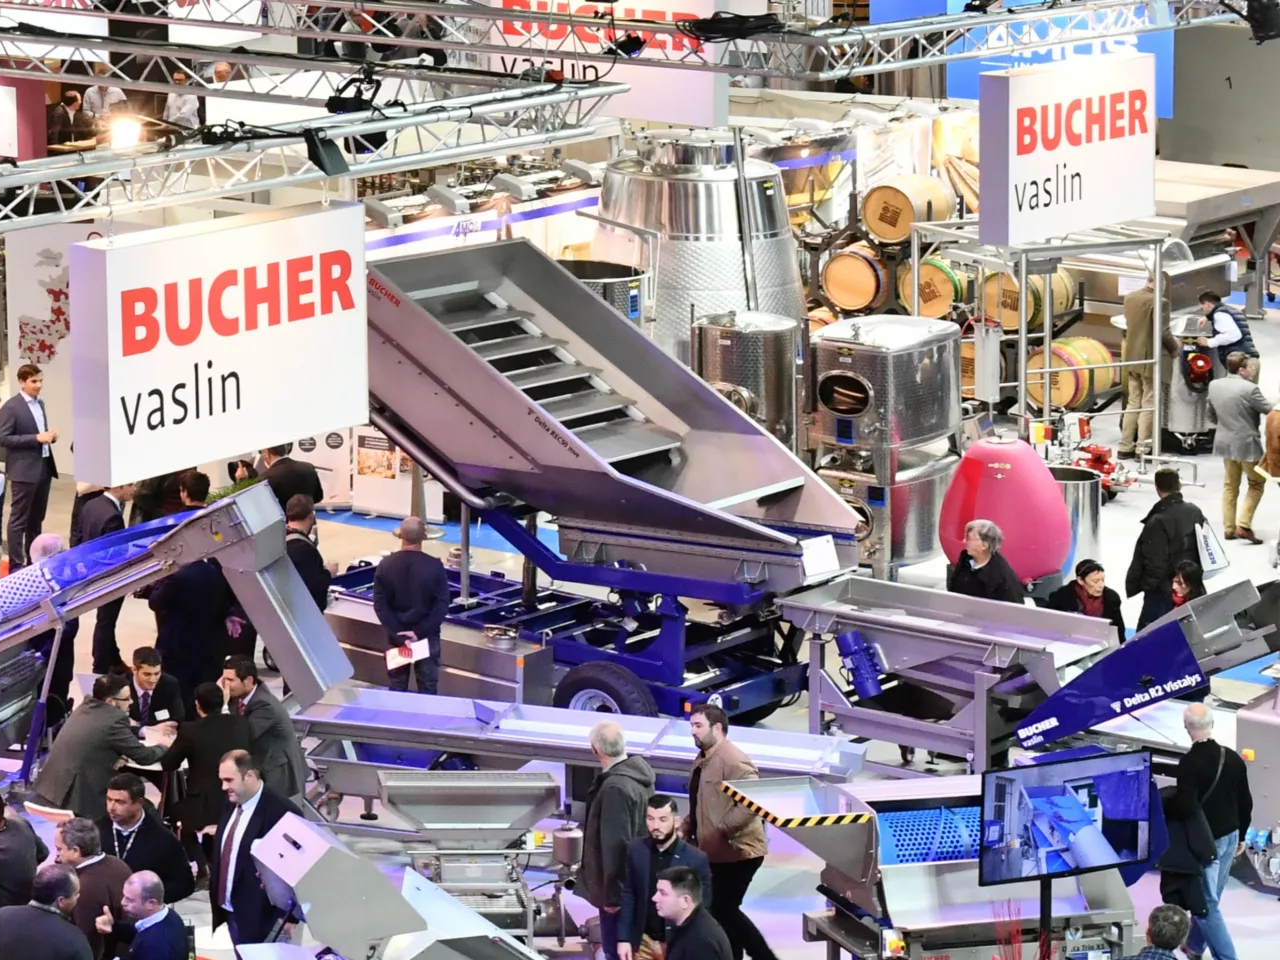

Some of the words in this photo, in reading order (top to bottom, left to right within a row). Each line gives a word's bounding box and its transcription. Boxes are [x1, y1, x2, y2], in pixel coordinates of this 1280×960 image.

[501, 0, 705, 54] BUCHER
[1016, 89, 1149, 156] BUCHER
[1015, 163, 1083, 212] vaslin
[120, 249, 356, 357] BUCHER
[369, 278, 401, 308] BUCHER
[120, 360, 241, 435] vaslin
[534, 415, 551, 433] Delta
[1123, 691, 1150, 709] Delta
[1148, 684, 1163, 699] R2
[1163, 673, 1201, 693] Vistalys
[1017, 717, 1059, 740] BUCHER
[1021, 734, 1044, 748] vaslin
[1062, 945, 1080, 953] Dta
